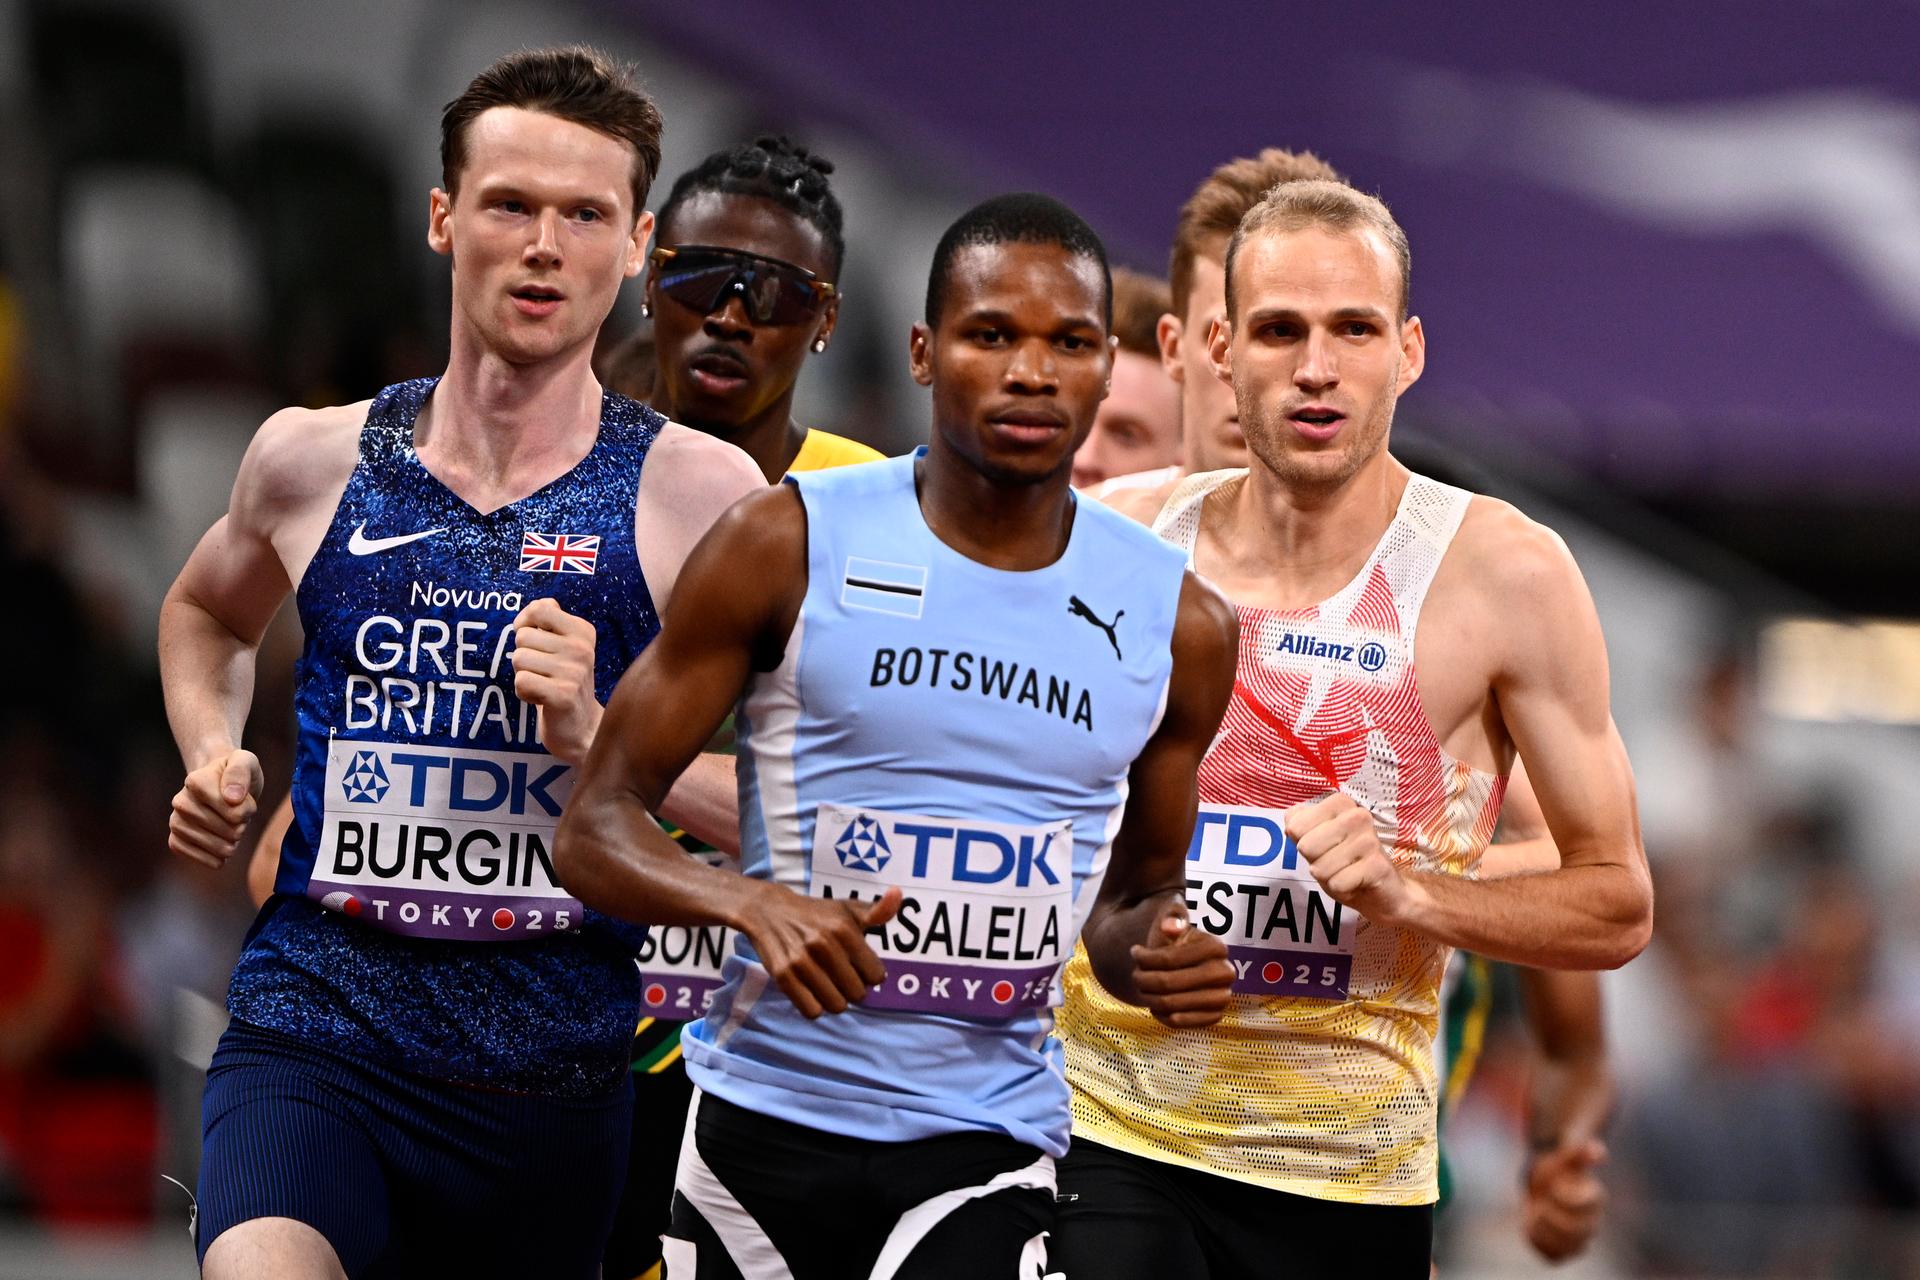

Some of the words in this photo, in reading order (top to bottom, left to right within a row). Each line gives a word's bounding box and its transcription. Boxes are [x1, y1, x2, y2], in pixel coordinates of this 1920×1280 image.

[410, 580, 522, 612] Novuna
[355, 615, 514, 679] GREA
[1276, 632, 1355, 662] Allianz
[345, 674, 543, 744] BRITAI
[870, 647, 1094, 732] BOTSWANA
[391, 753, 572, 817] TDK
[332, 820, 564, 888] BURGIN
[893, 822, 1061, 887] TDK
[1185, 811, 1299, 870] TD
[526, 909, 571, 931] 25
[823, 884, 1060, 961] ASALELA
[1293, 964, 1337, 987] 25
